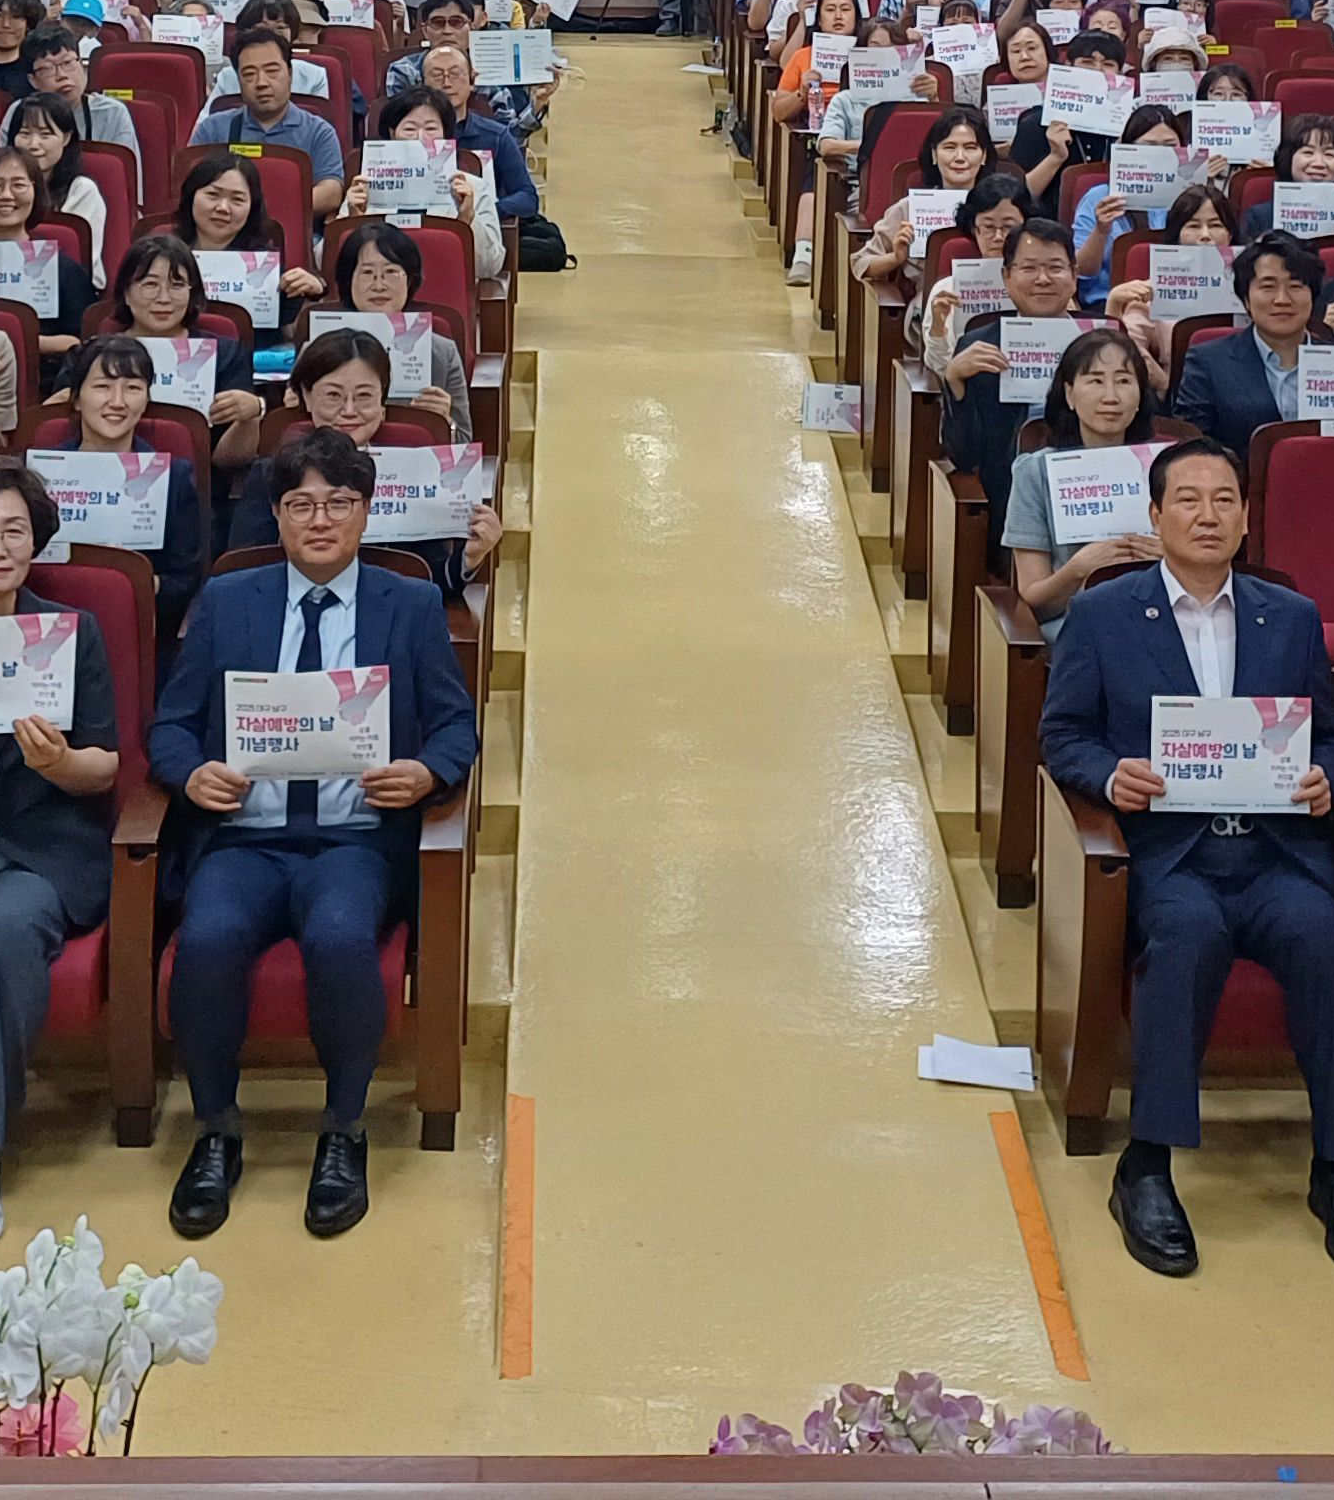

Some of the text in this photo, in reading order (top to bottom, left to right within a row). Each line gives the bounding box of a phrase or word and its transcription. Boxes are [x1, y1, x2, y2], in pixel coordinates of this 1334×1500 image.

[48, 490, 120, 506] 살예방의 날
[424, 484, 437, 498] 날
[60, 508, 87, 521] 행사
[369, 502, 407, 515] 념행사
[1, 660, 18, 677] 날
[235, 716, 334, 732] 자살예방의 날
[236, 736, 298, 752] 기념행사
[1161, 741, 1257, 759] 자살예방의 날
[1162, 762, 1222, 779] 기념행사
